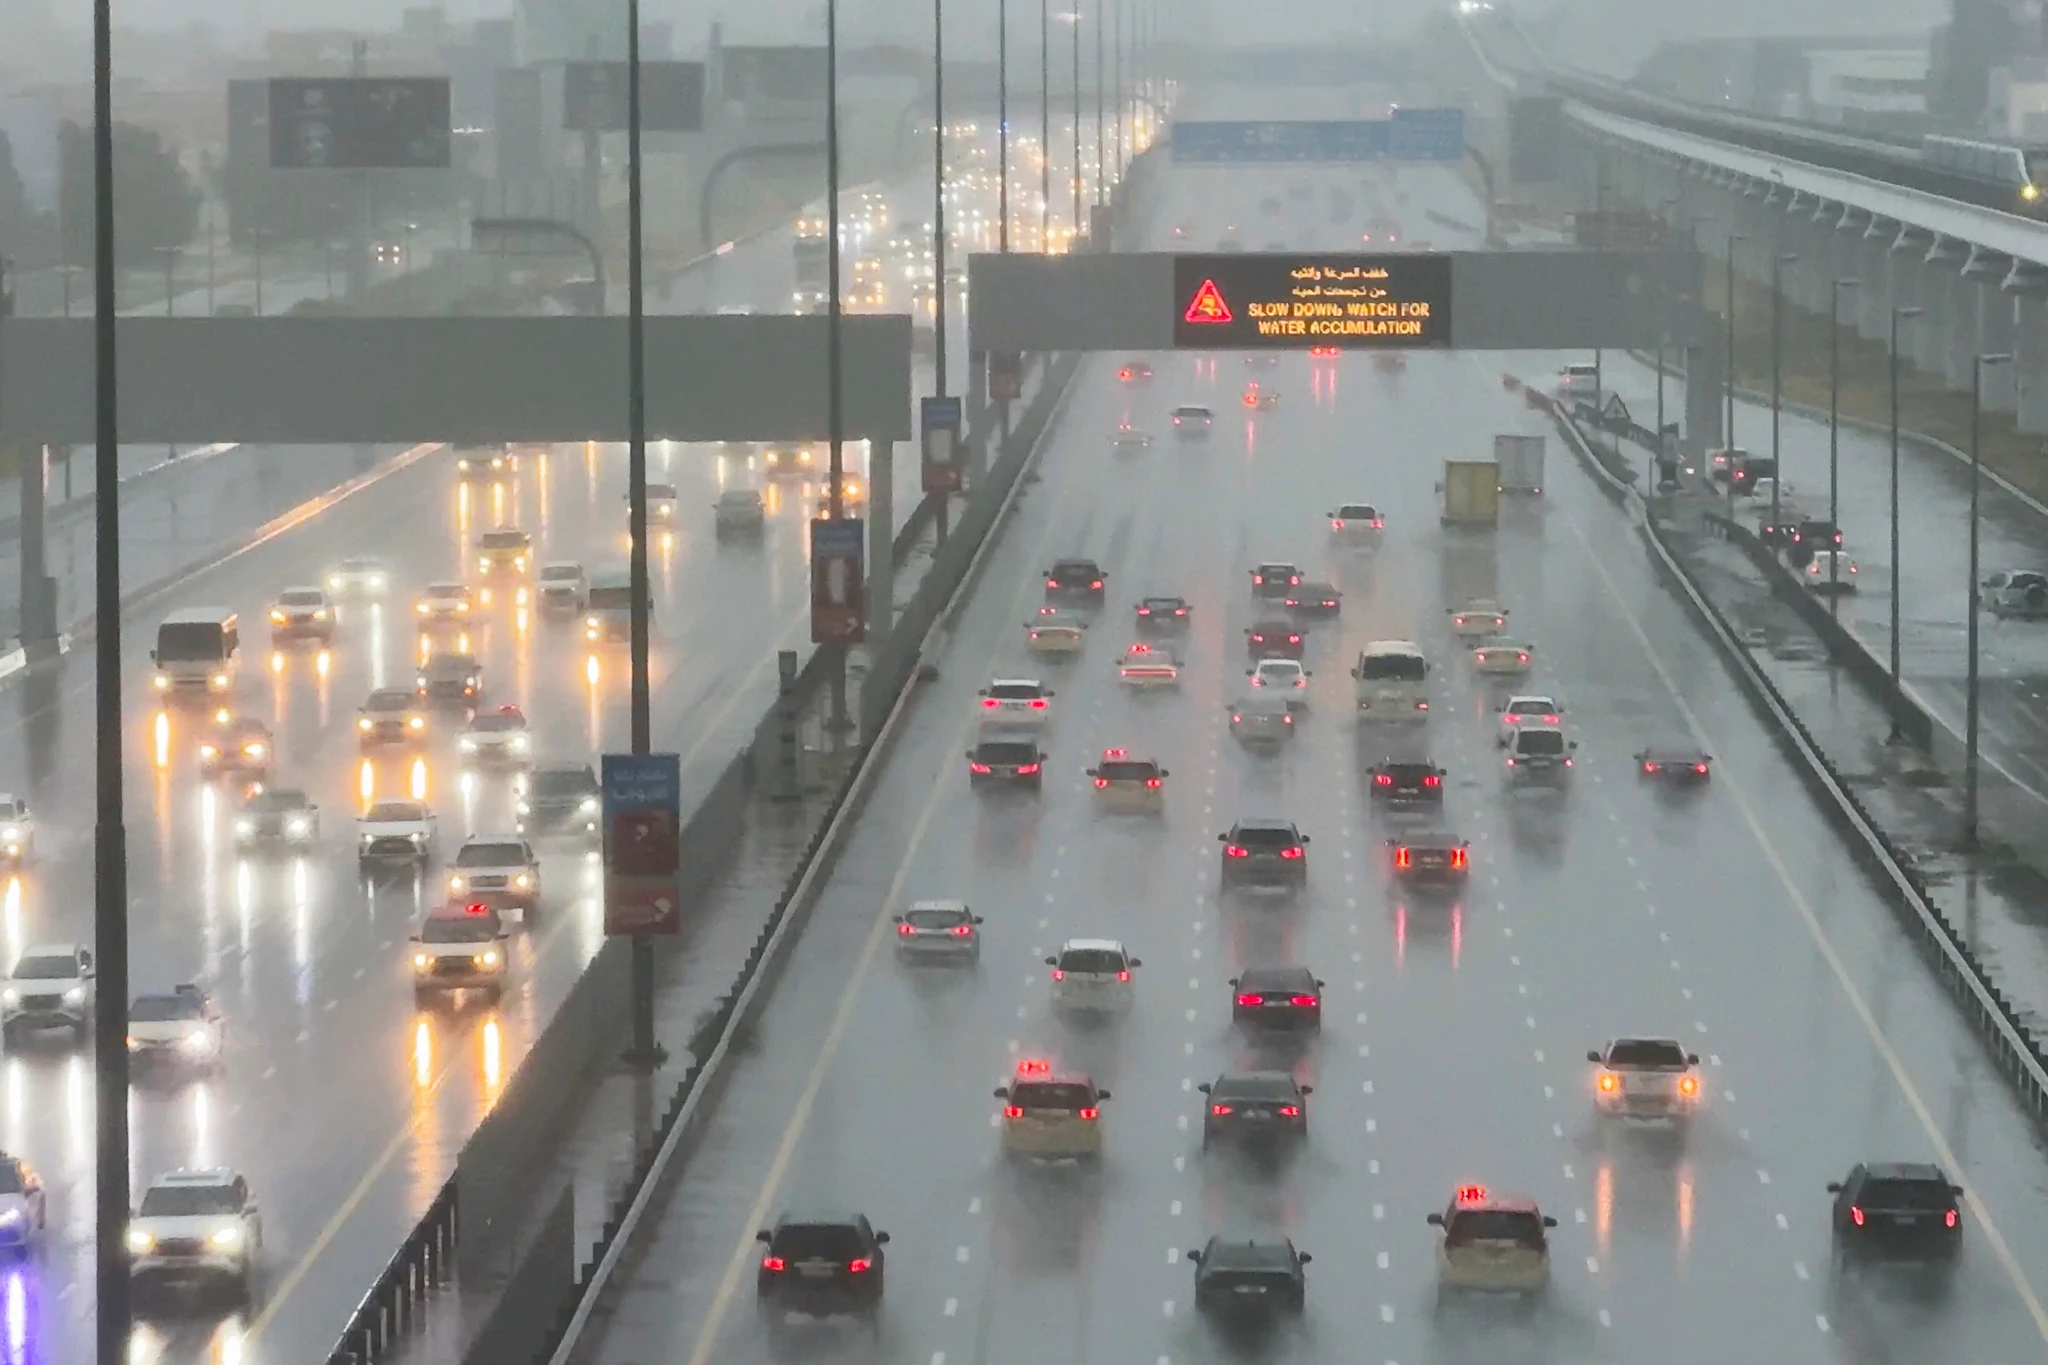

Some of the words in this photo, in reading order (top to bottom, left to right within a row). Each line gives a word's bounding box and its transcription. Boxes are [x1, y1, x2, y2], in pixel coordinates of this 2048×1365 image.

[1369, 287, 1387, 299] من
[1248, 302, 1289, 317] SLOW
[1346, 302, 1397, 317] WATCH
[1400, 302, 1430, 317] FOR
[1257, 320, 1306, 335] WATER
[1309, 320, 1422, 335] ACCUMULATION
